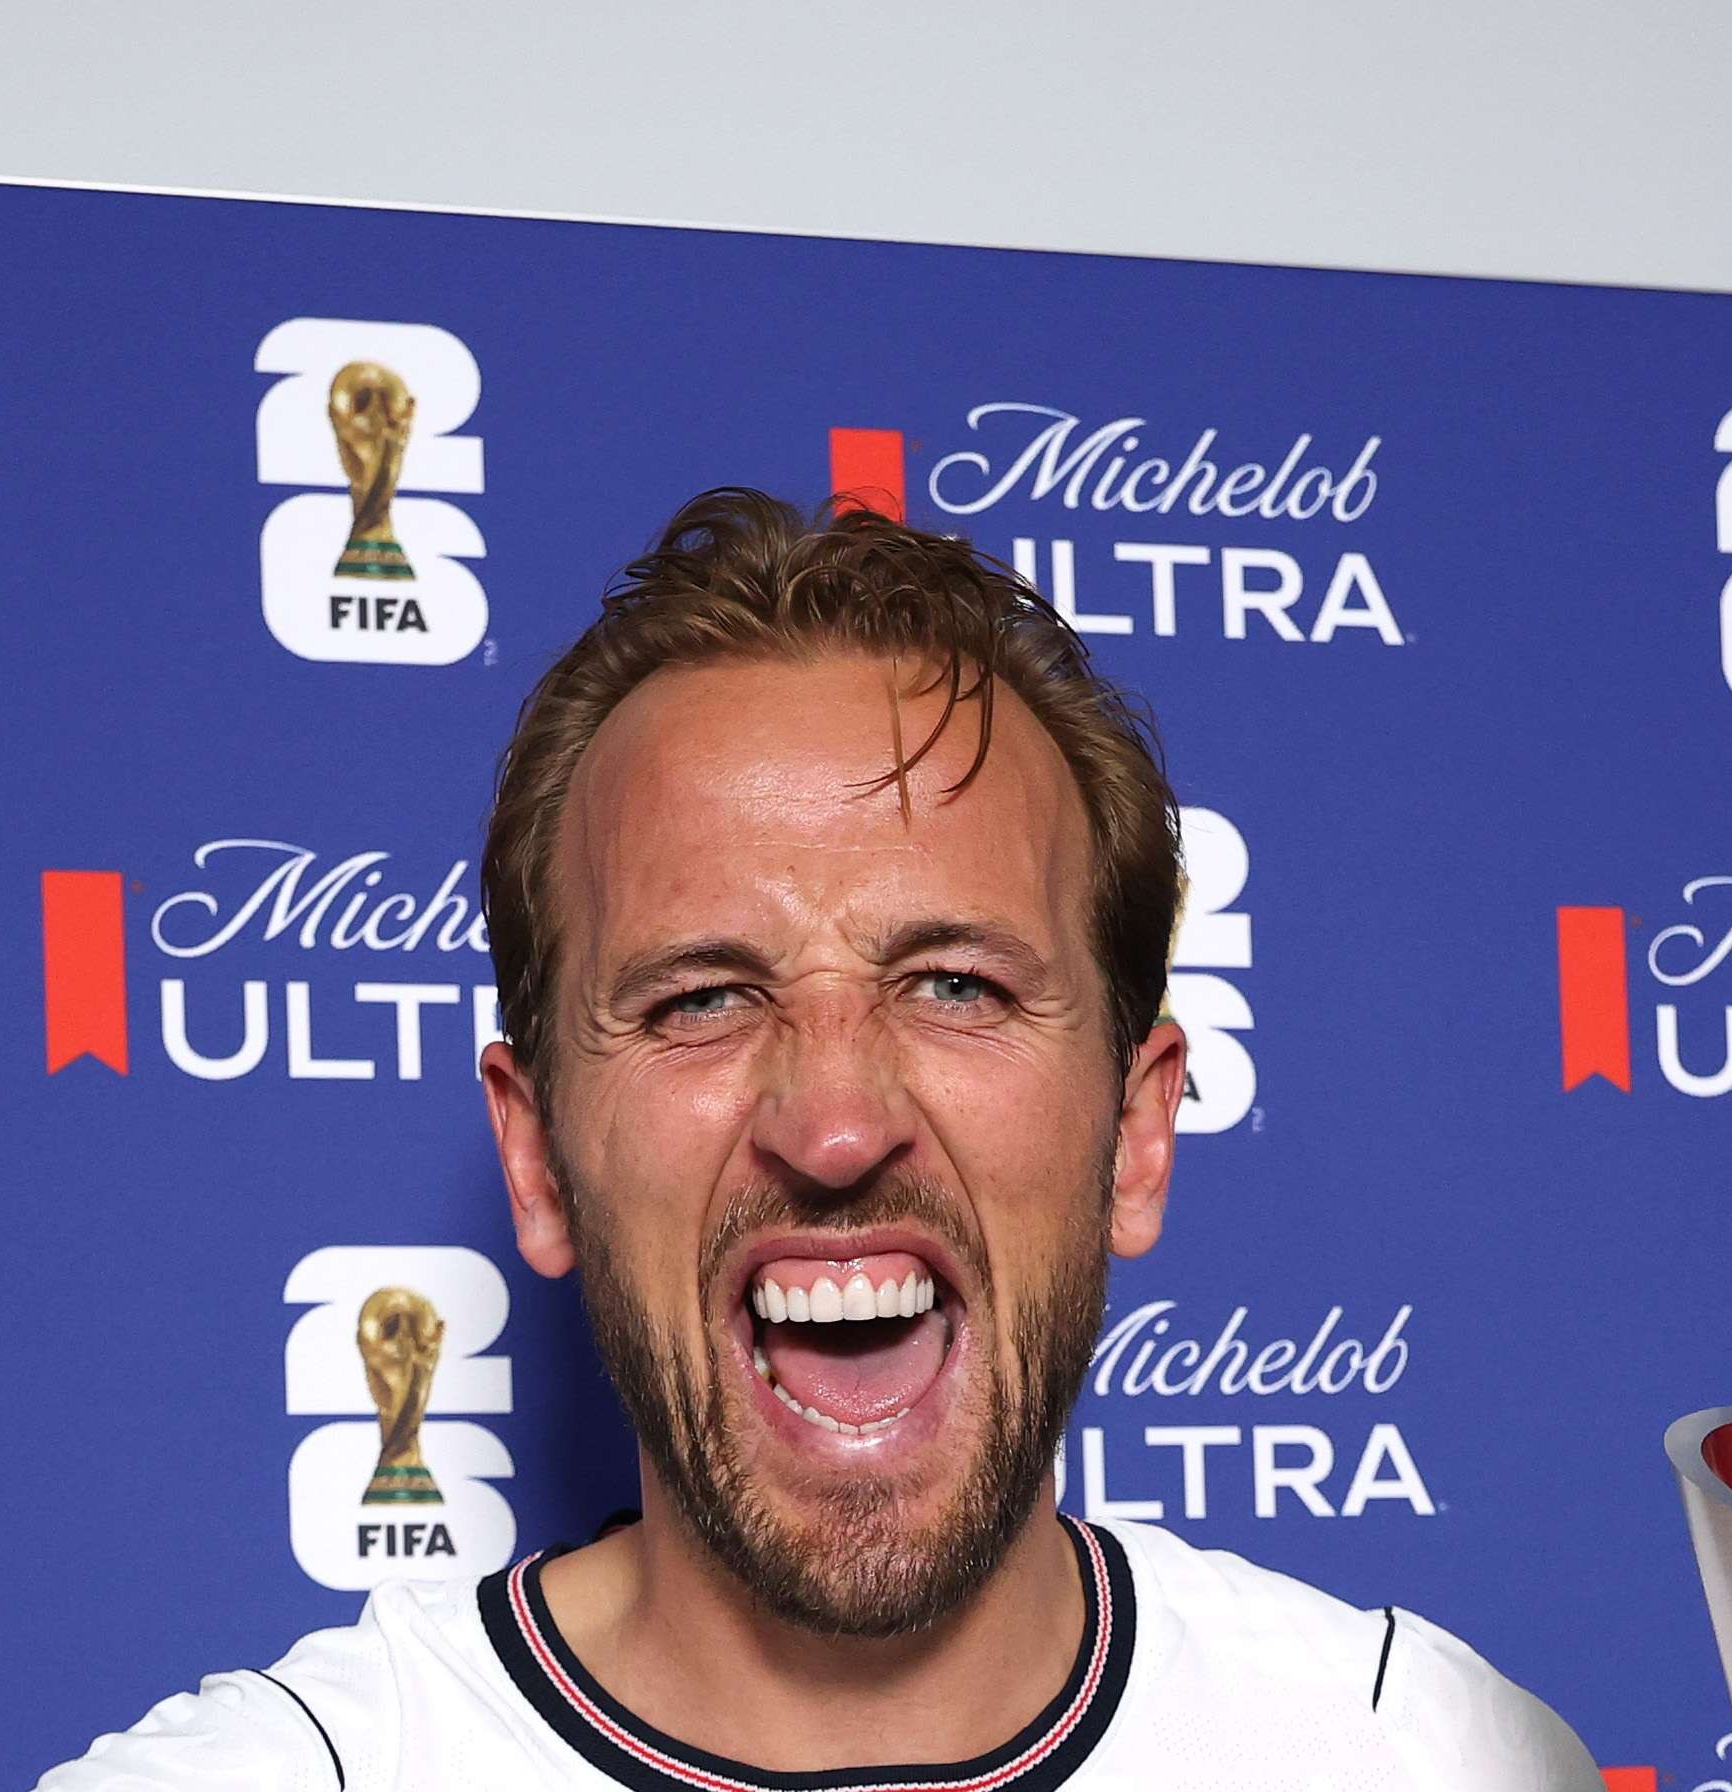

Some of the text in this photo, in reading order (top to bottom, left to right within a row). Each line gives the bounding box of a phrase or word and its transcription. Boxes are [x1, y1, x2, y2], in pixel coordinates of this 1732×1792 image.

[929, 403, 1381, 522] Michelob
[330, 596, 428, 632] FIFA
[1054, 1425, 1435, 1519] LTRA
[358, 1523, 457, 1557] FIFA
